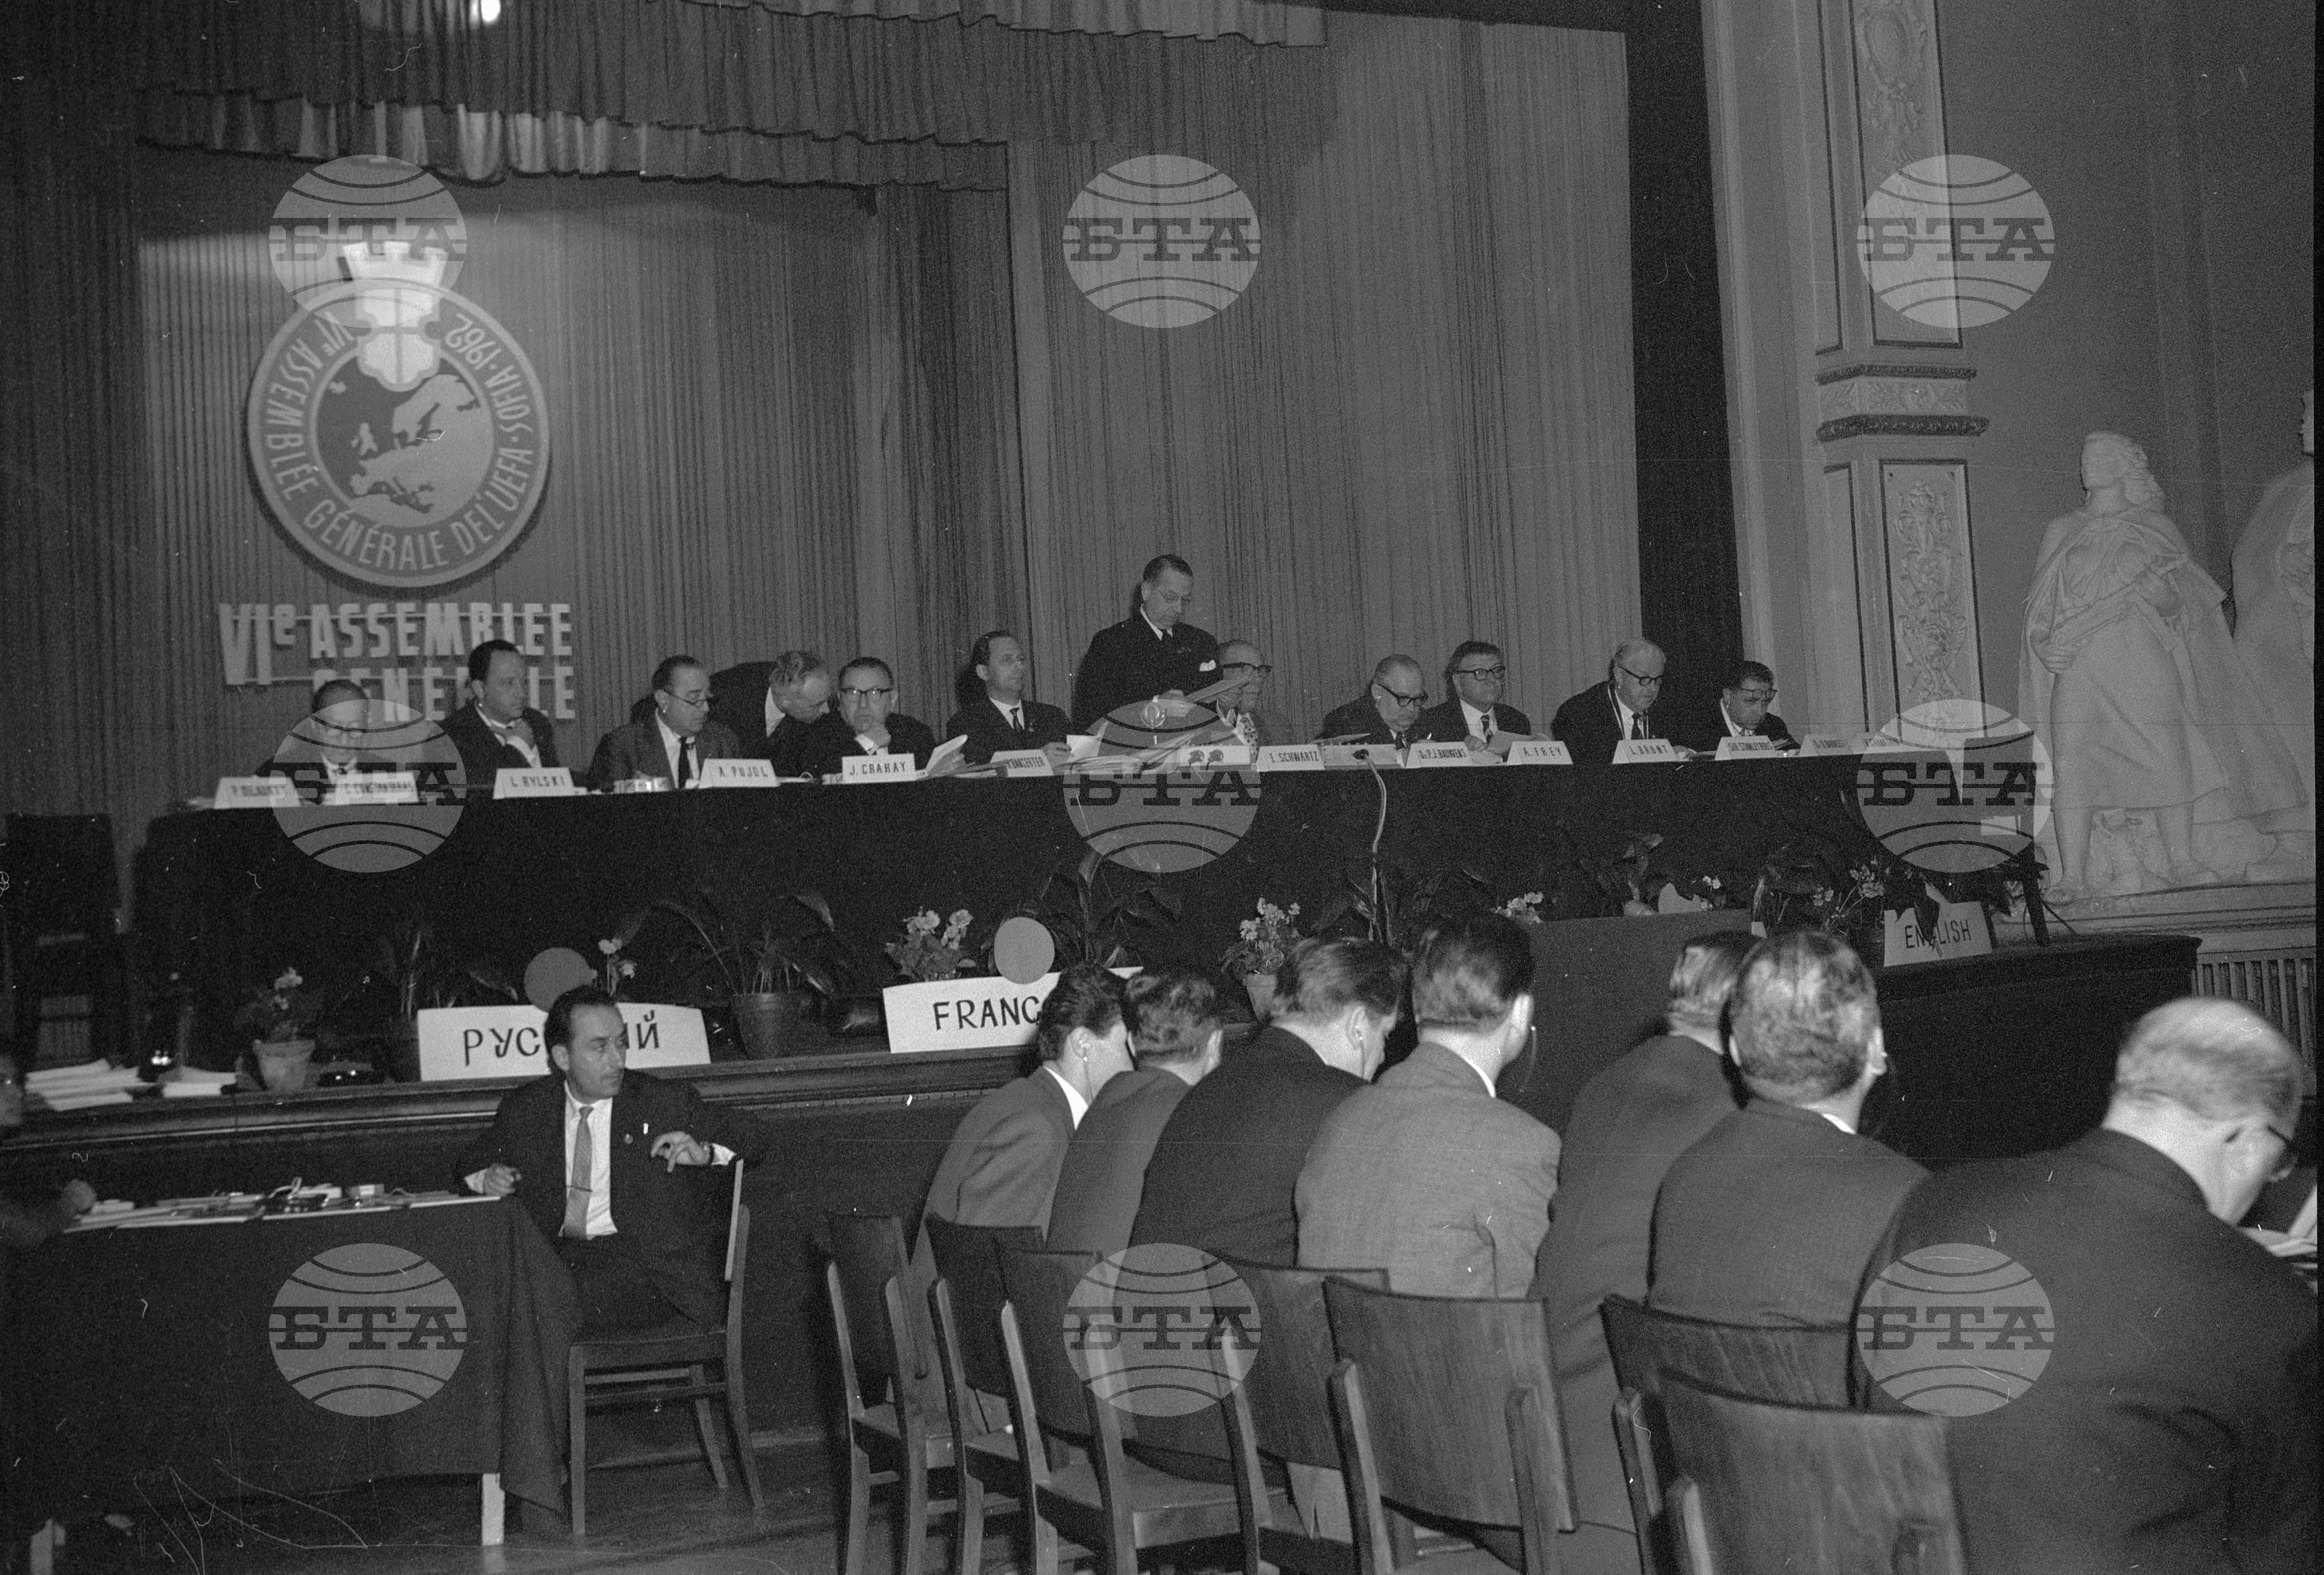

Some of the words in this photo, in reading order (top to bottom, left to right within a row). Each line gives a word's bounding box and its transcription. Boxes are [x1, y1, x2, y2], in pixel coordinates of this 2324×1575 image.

[445, 312, 501, 370] 1962
[485, 364, 535, 434] SOFIA
[1534, 746, 1562, 756] FREY
[1637, 744, 1668, 754] BRUNT
[1278, 750, 1319, 763] SCHWARTZ
[731, 766, 768, 777] PUJOL
[849, 765, 858, 776] J.
[862, 761, 906, 775] CRAHAY
[522, 775, 565, 787] RYLSKI
[463, 1009, 660, 1067] РУСЙ
